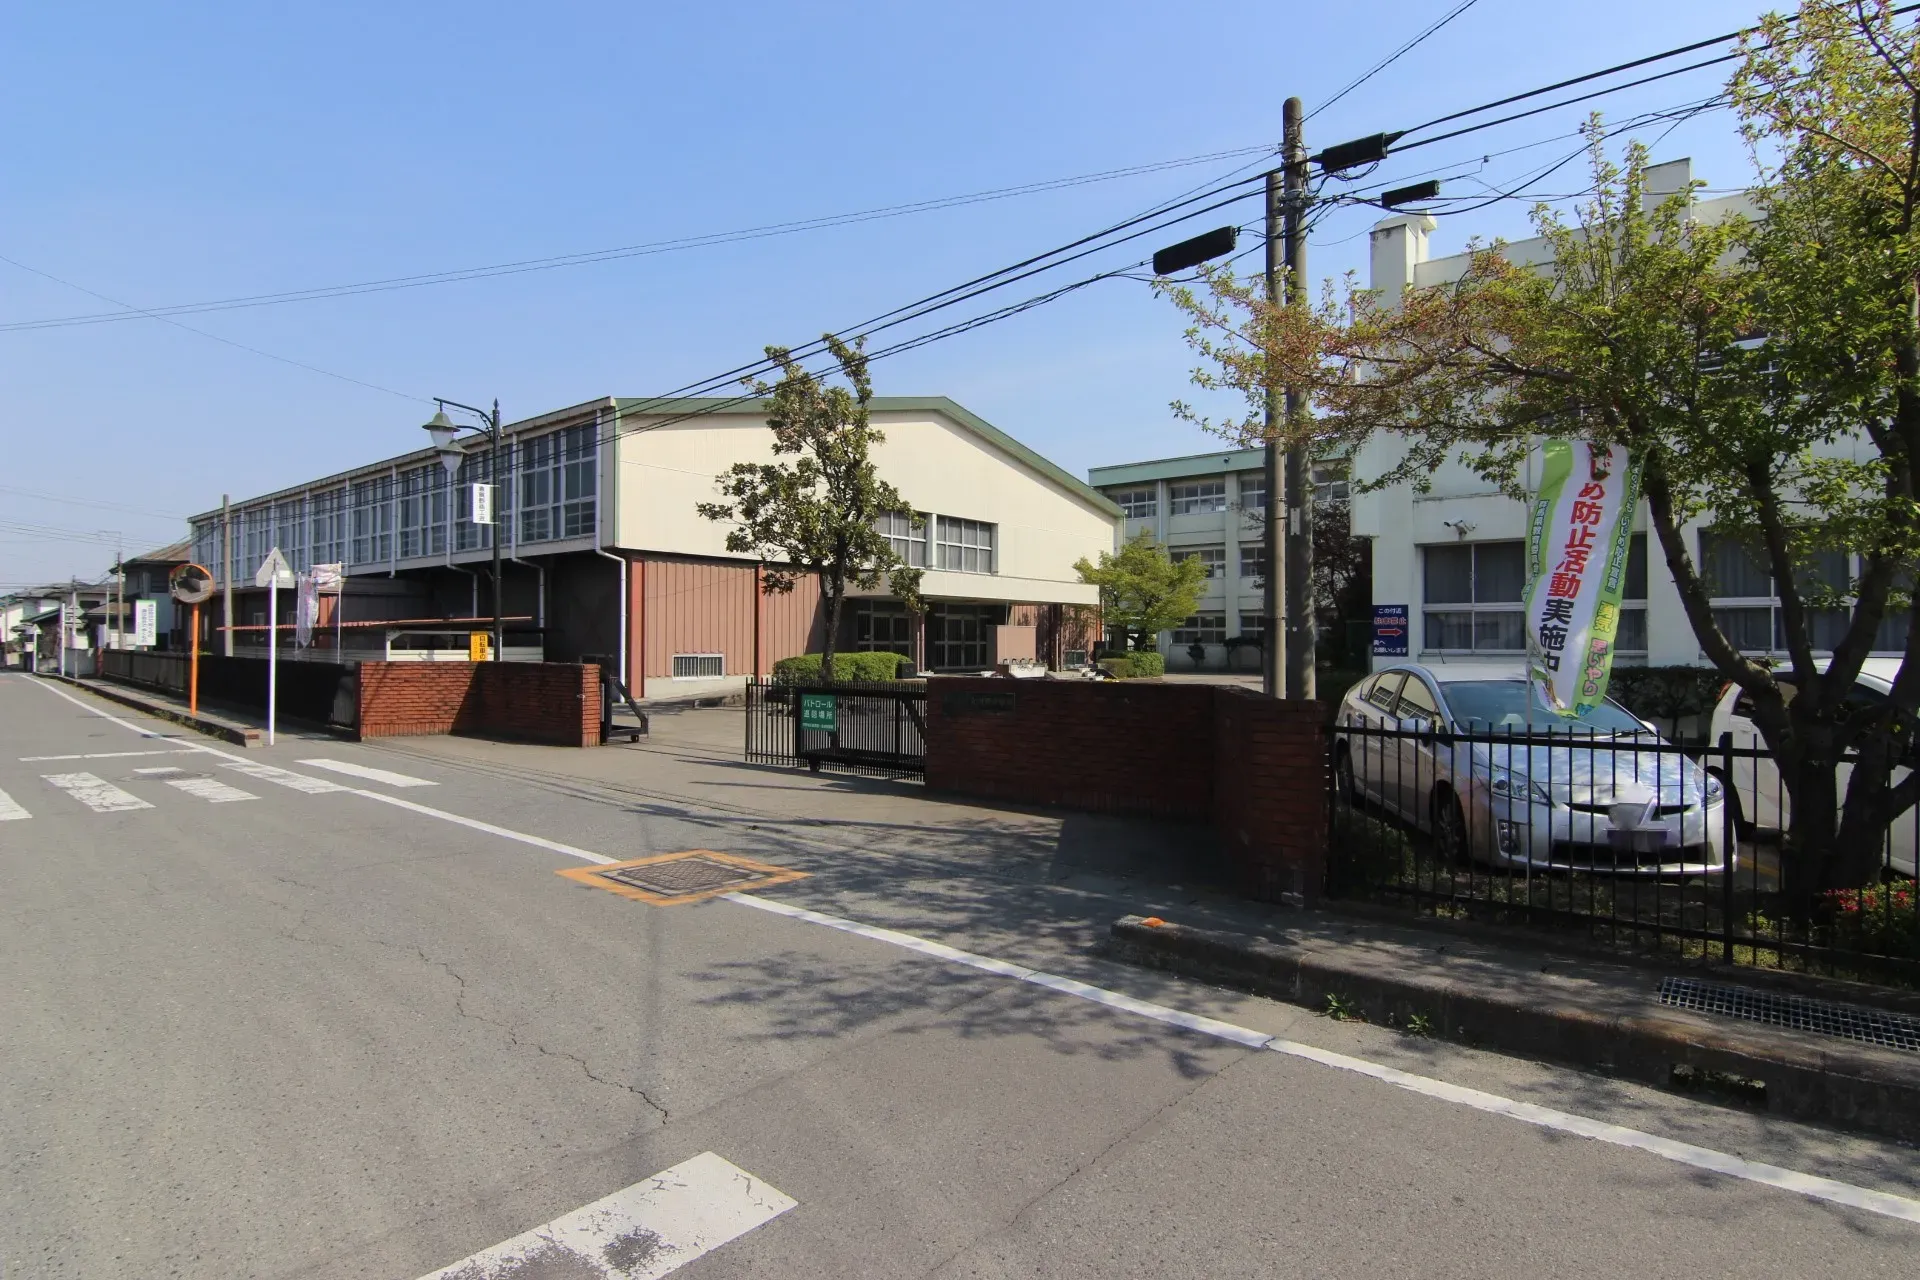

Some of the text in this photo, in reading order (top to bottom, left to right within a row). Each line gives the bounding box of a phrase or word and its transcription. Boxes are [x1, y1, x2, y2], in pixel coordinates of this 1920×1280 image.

[1583, 637, 1608, 697] 思いやり
[804, 700, 833, 708] パトロール
